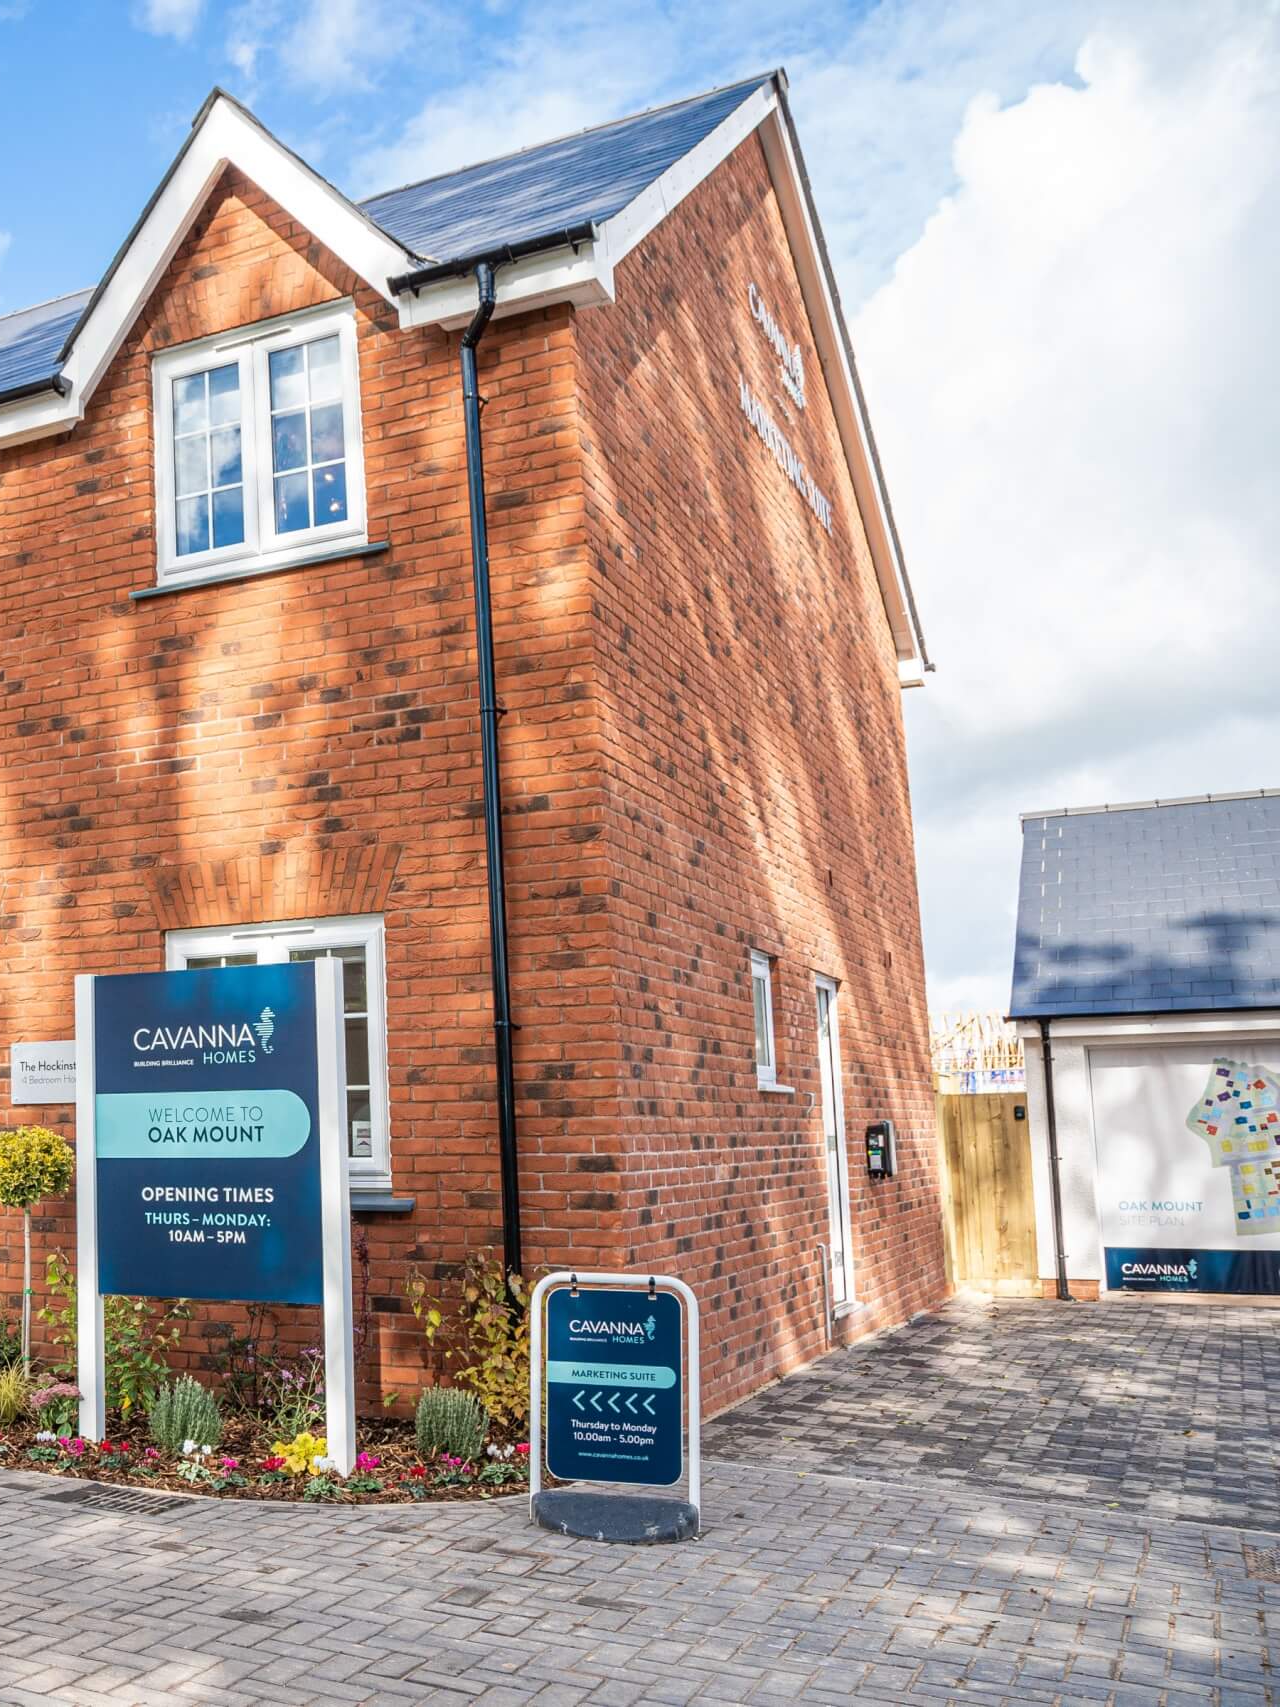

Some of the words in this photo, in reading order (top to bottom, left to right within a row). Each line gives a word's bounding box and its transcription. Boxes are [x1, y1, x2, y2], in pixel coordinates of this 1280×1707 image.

[133, 1023, 256, 1051] CAVANNA
[134, 1060, 161, 1068] BUILDING
[161, 1059, 195, 1067] BRILLIANCE
[203, 1050, 256, 1065] HOMES
[19, 1060, 36, 1073] The
[148, 1106, 235, 1122] WELCOME
[240, 1105, 263, 1121] TO
[148, 1126, 187, 1143] OAK
[193, 1125, 264, 1142] MOUNT
[141, 1187, 219, 1202] OPENING
[223, 1187, 274, 1203] TIMES
[1119, 1201, 1148, 1211] OAK
[1151, 1201, 1204, 1212] MOUNT
[144, 1212, 190, 1225] THURS
[202, 1213, 271, 1227] MONDAY:
[1120, 1216, 1147, 1226] SITE
[1150, 1215, 1185, 1226] PLAN
[168, 1229, 205, 1243] 10AM
[217, 1231, 247, 1244] 5PM
[1121, 1263, 1188, 1276] CAVANNA
[1159, 1274, 1189, 1283] HOMES
[569, 1319, 645, 1336] CAVANNA
[612, 1335, 645, 1345] HOMES
[571, 1369, 628, 1381] MARKETING
[630, 1372, 657, 1382] SUITE
[571, 1419, 609, 1432] Thursday
[610, 1422, 620, 1431] to
[622, 1422, 657, 1435] Monday
[573, 1431, 612, 1442] 10.00am
[619, 1434, 655, 1447] 5.00pm
